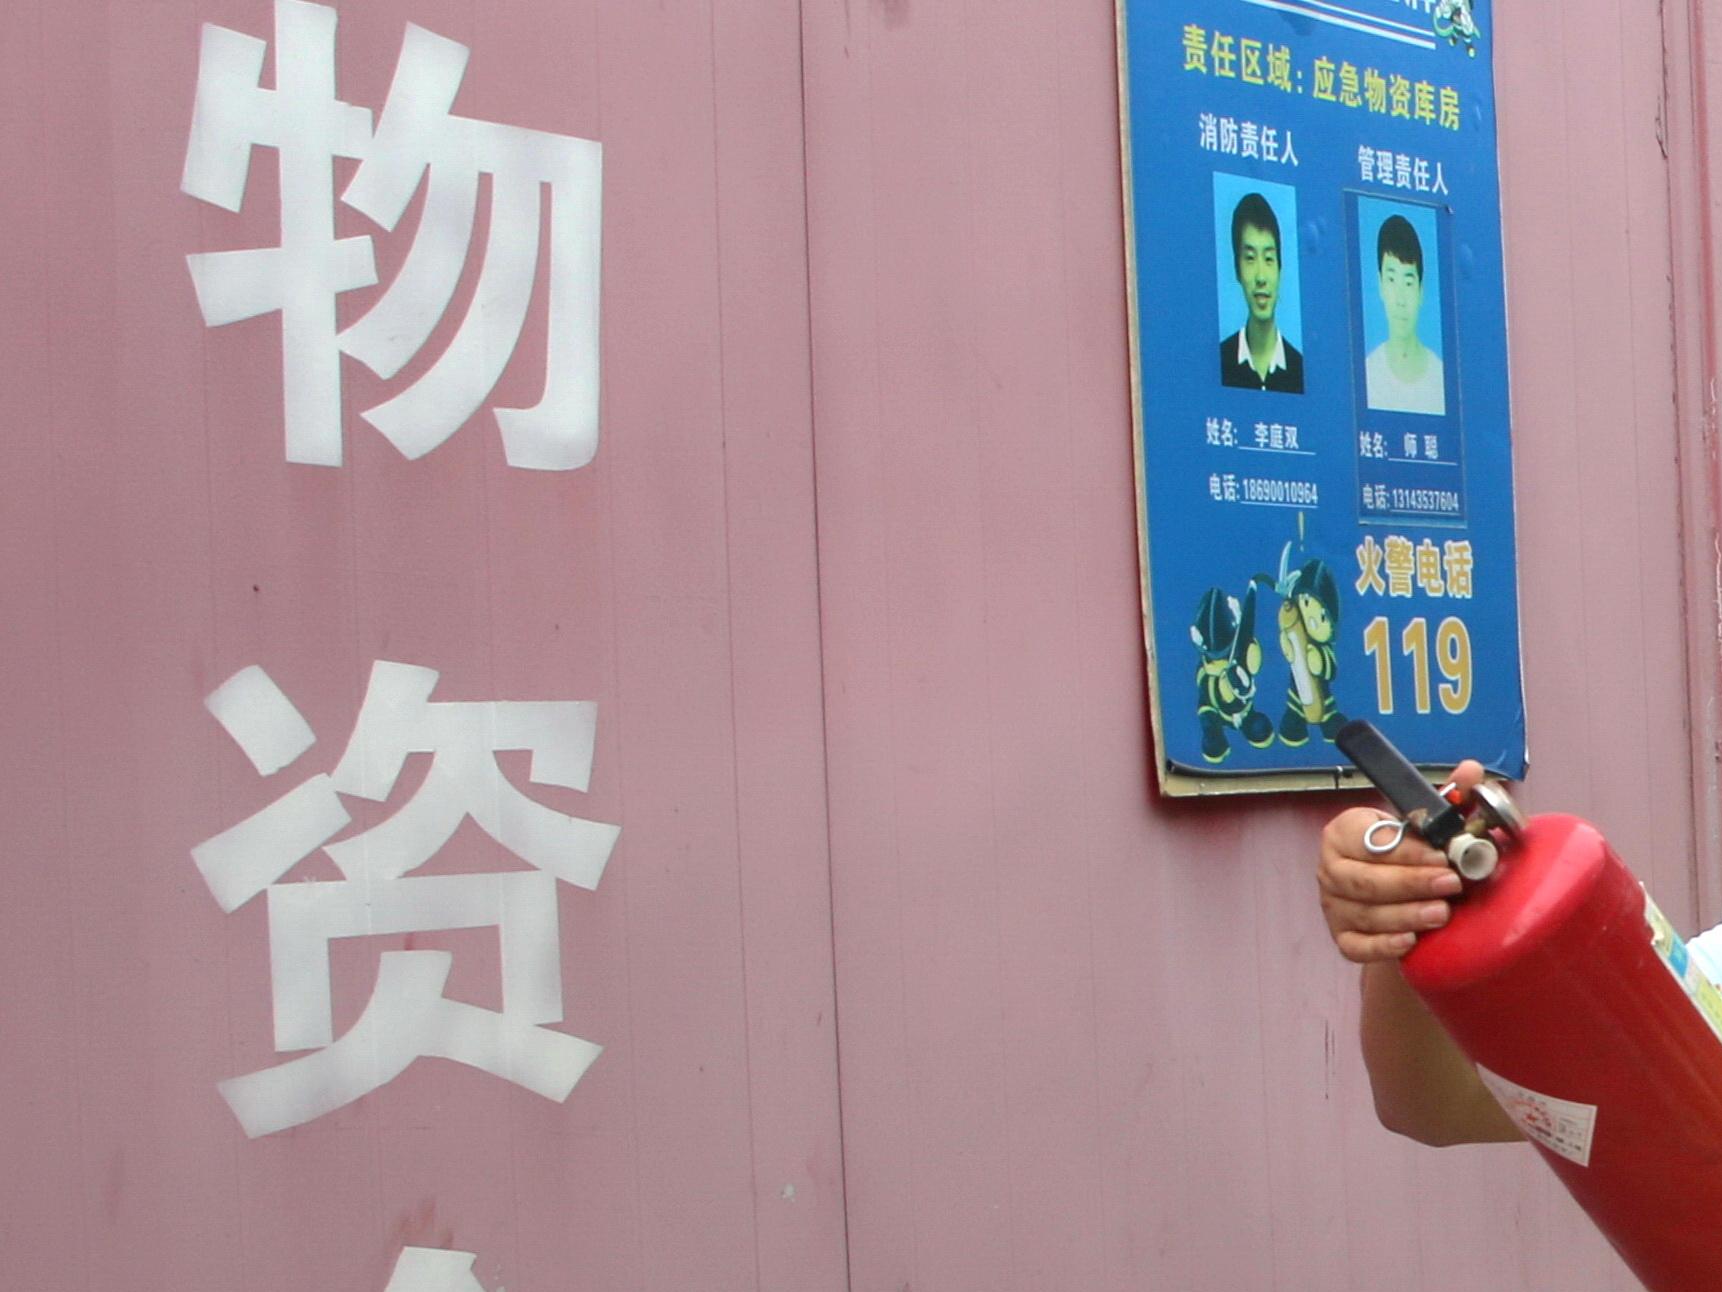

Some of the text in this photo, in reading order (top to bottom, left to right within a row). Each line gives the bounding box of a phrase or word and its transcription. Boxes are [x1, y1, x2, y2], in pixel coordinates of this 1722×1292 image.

[1183, 24, 1460, 131] 责任区域：应急物资库房
[1199, 113, 1299, 167] 消防责任人
[1357, 144, 1449, 196] 管理责任人
[1206, 417, 1238, 447] 姓名：
[1360, 430, 1389, 459] 姓名：
[1209, 473, 1240, 502] 电话：
[1362, 484, 1391, 510] 电话：
[1355, 535, 1474, 598] 火警电话
[1363, 616, 1472, 715] 119
